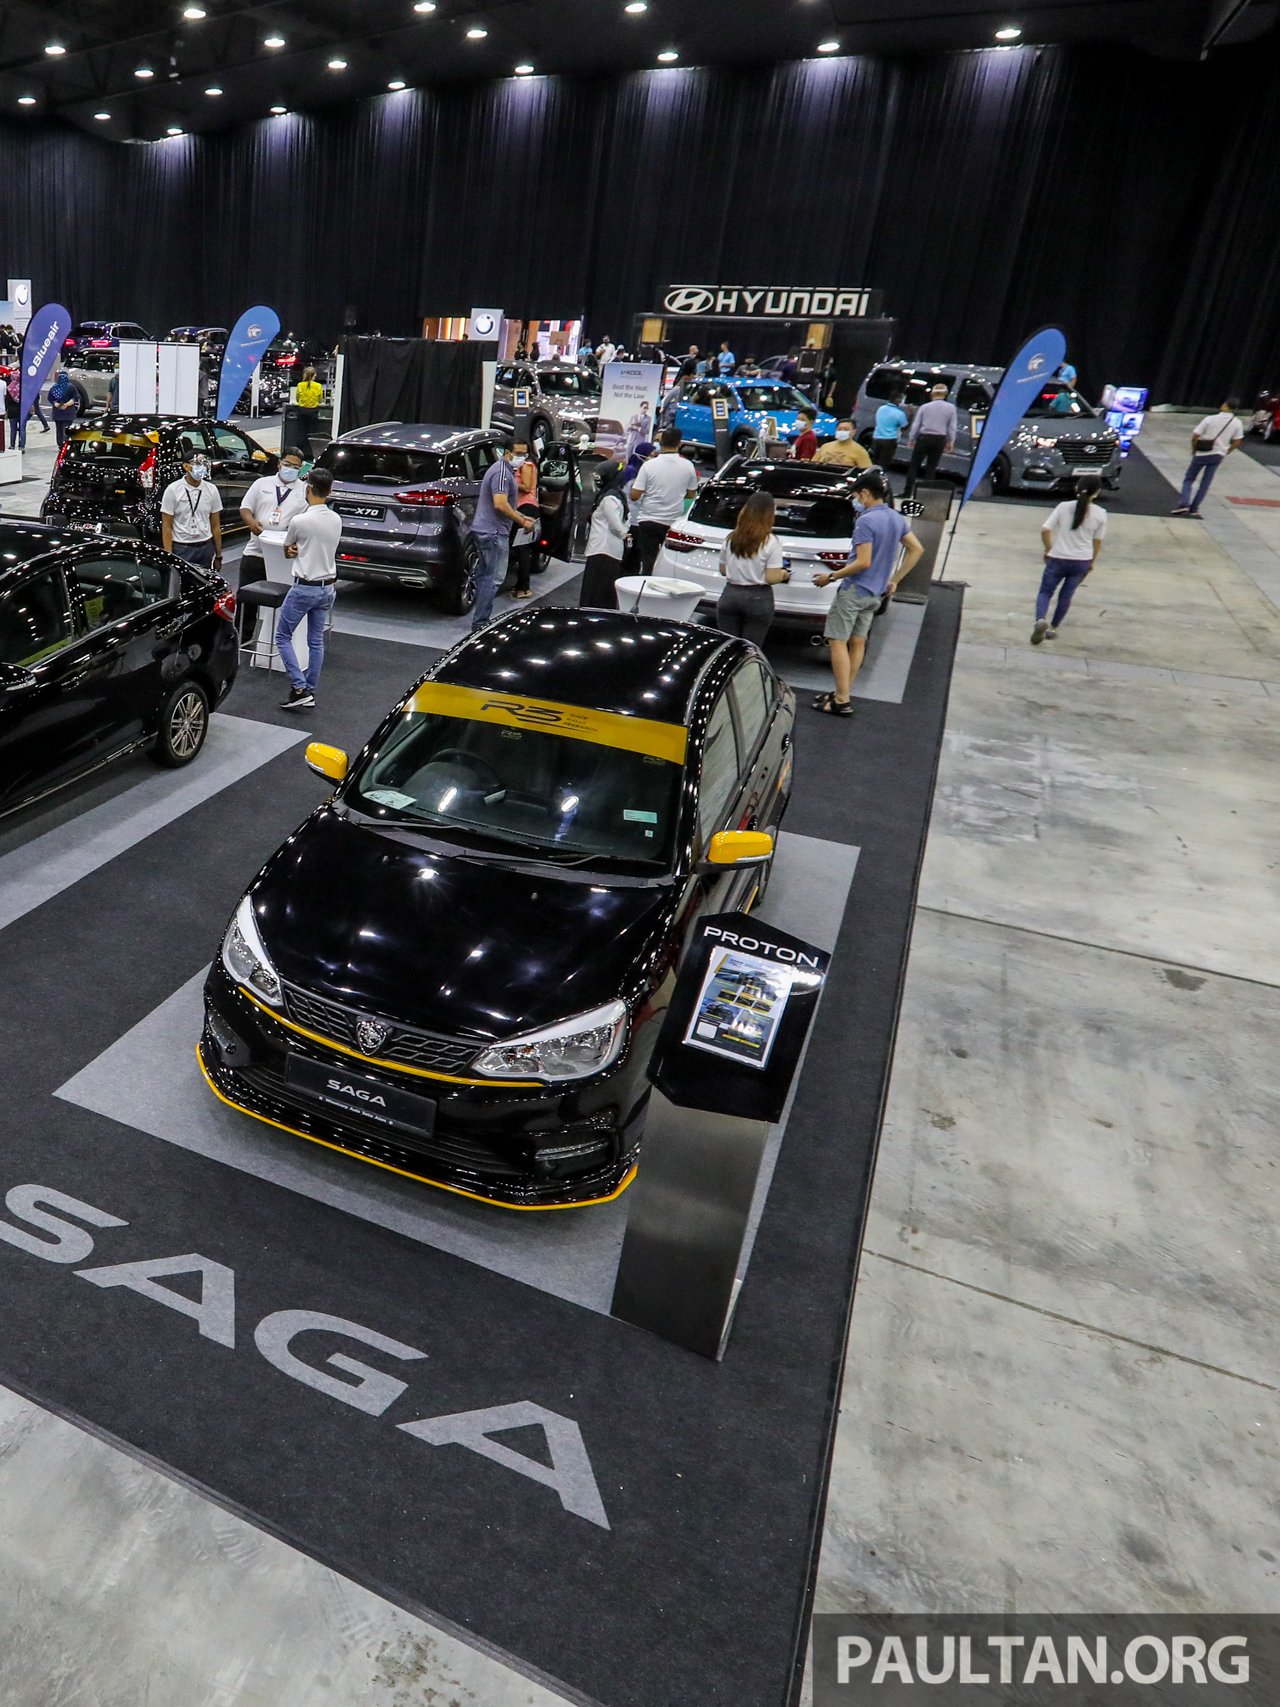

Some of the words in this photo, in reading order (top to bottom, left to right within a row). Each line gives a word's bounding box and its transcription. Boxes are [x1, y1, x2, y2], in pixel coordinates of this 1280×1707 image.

[714, 291, 870, 316] HYUNDAI
[32, 321, 59, 368] Blueair
[356, 507, 379, 516] X70
[703, 926, 819, 967] PROTON
[326, 1079, 386, 1107] SAGA
